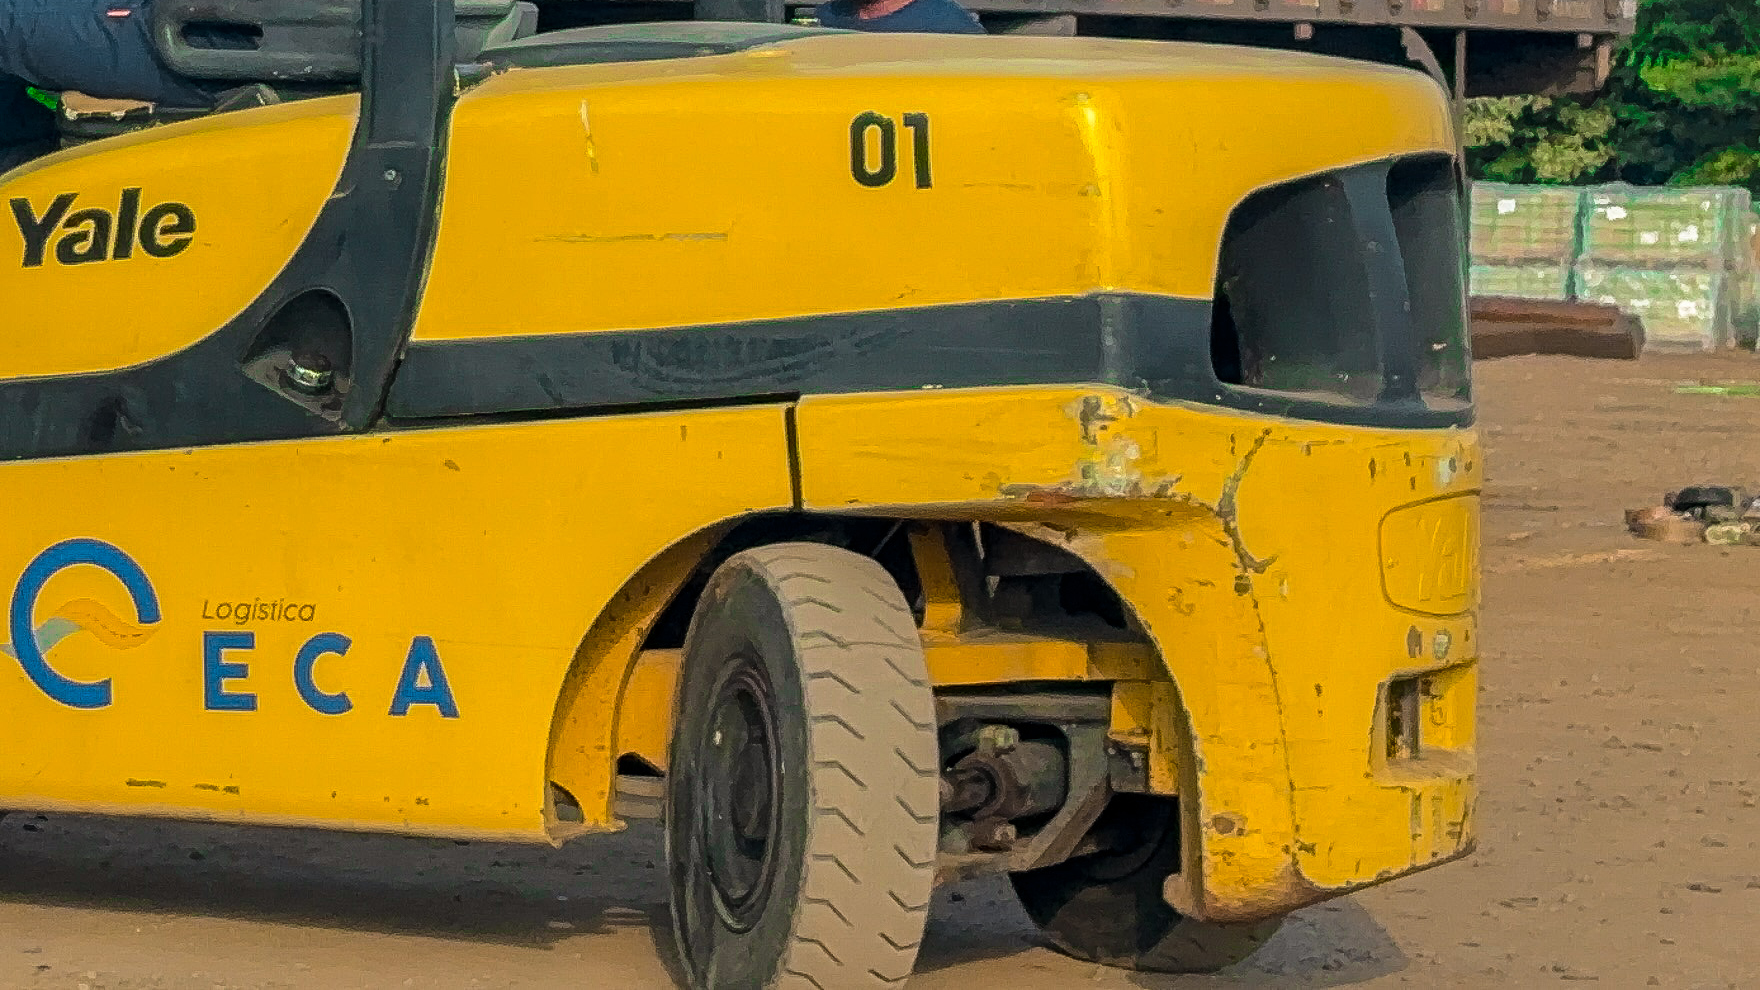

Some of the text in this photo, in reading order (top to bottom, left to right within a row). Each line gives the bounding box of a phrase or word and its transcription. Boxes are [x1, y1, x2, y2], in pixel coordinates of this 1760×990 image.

[849, 110, 933, 190] 01
[9, 187, 197, 268] Yale
[203, 630, 461, 719] ECA
